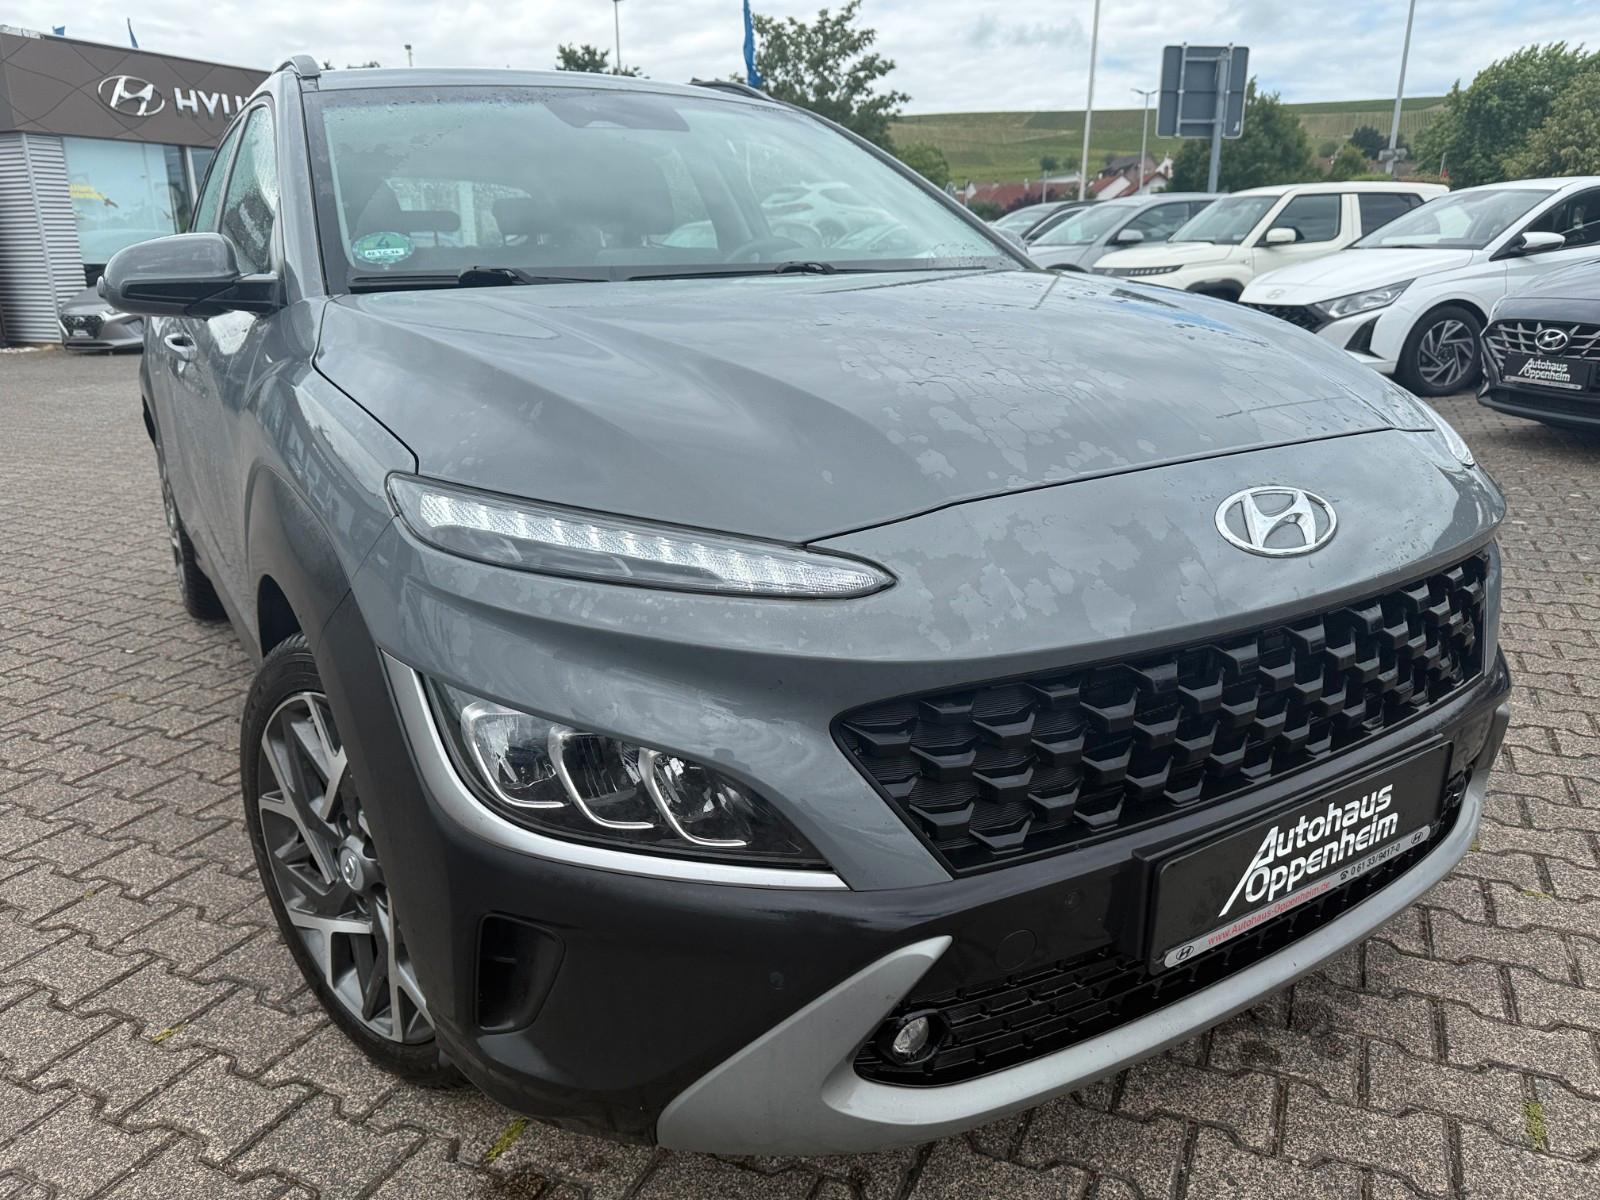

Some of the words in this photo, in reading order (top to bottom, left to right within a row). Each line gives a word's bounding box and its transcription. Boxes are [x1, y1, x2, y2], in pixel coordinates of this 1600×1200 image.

[173, 87, 249, 114] HYU
[1518, 358, 1568, 375] Autohaus
[1524, 367, 1571, 382] Oppenheim
[1218, 784, 1393, 918] Autohaus
[1245, 812, 1399, 902] Oppenheim
[1207, 881, 1331, 945] www.Autohaus-Oppenheim.de
